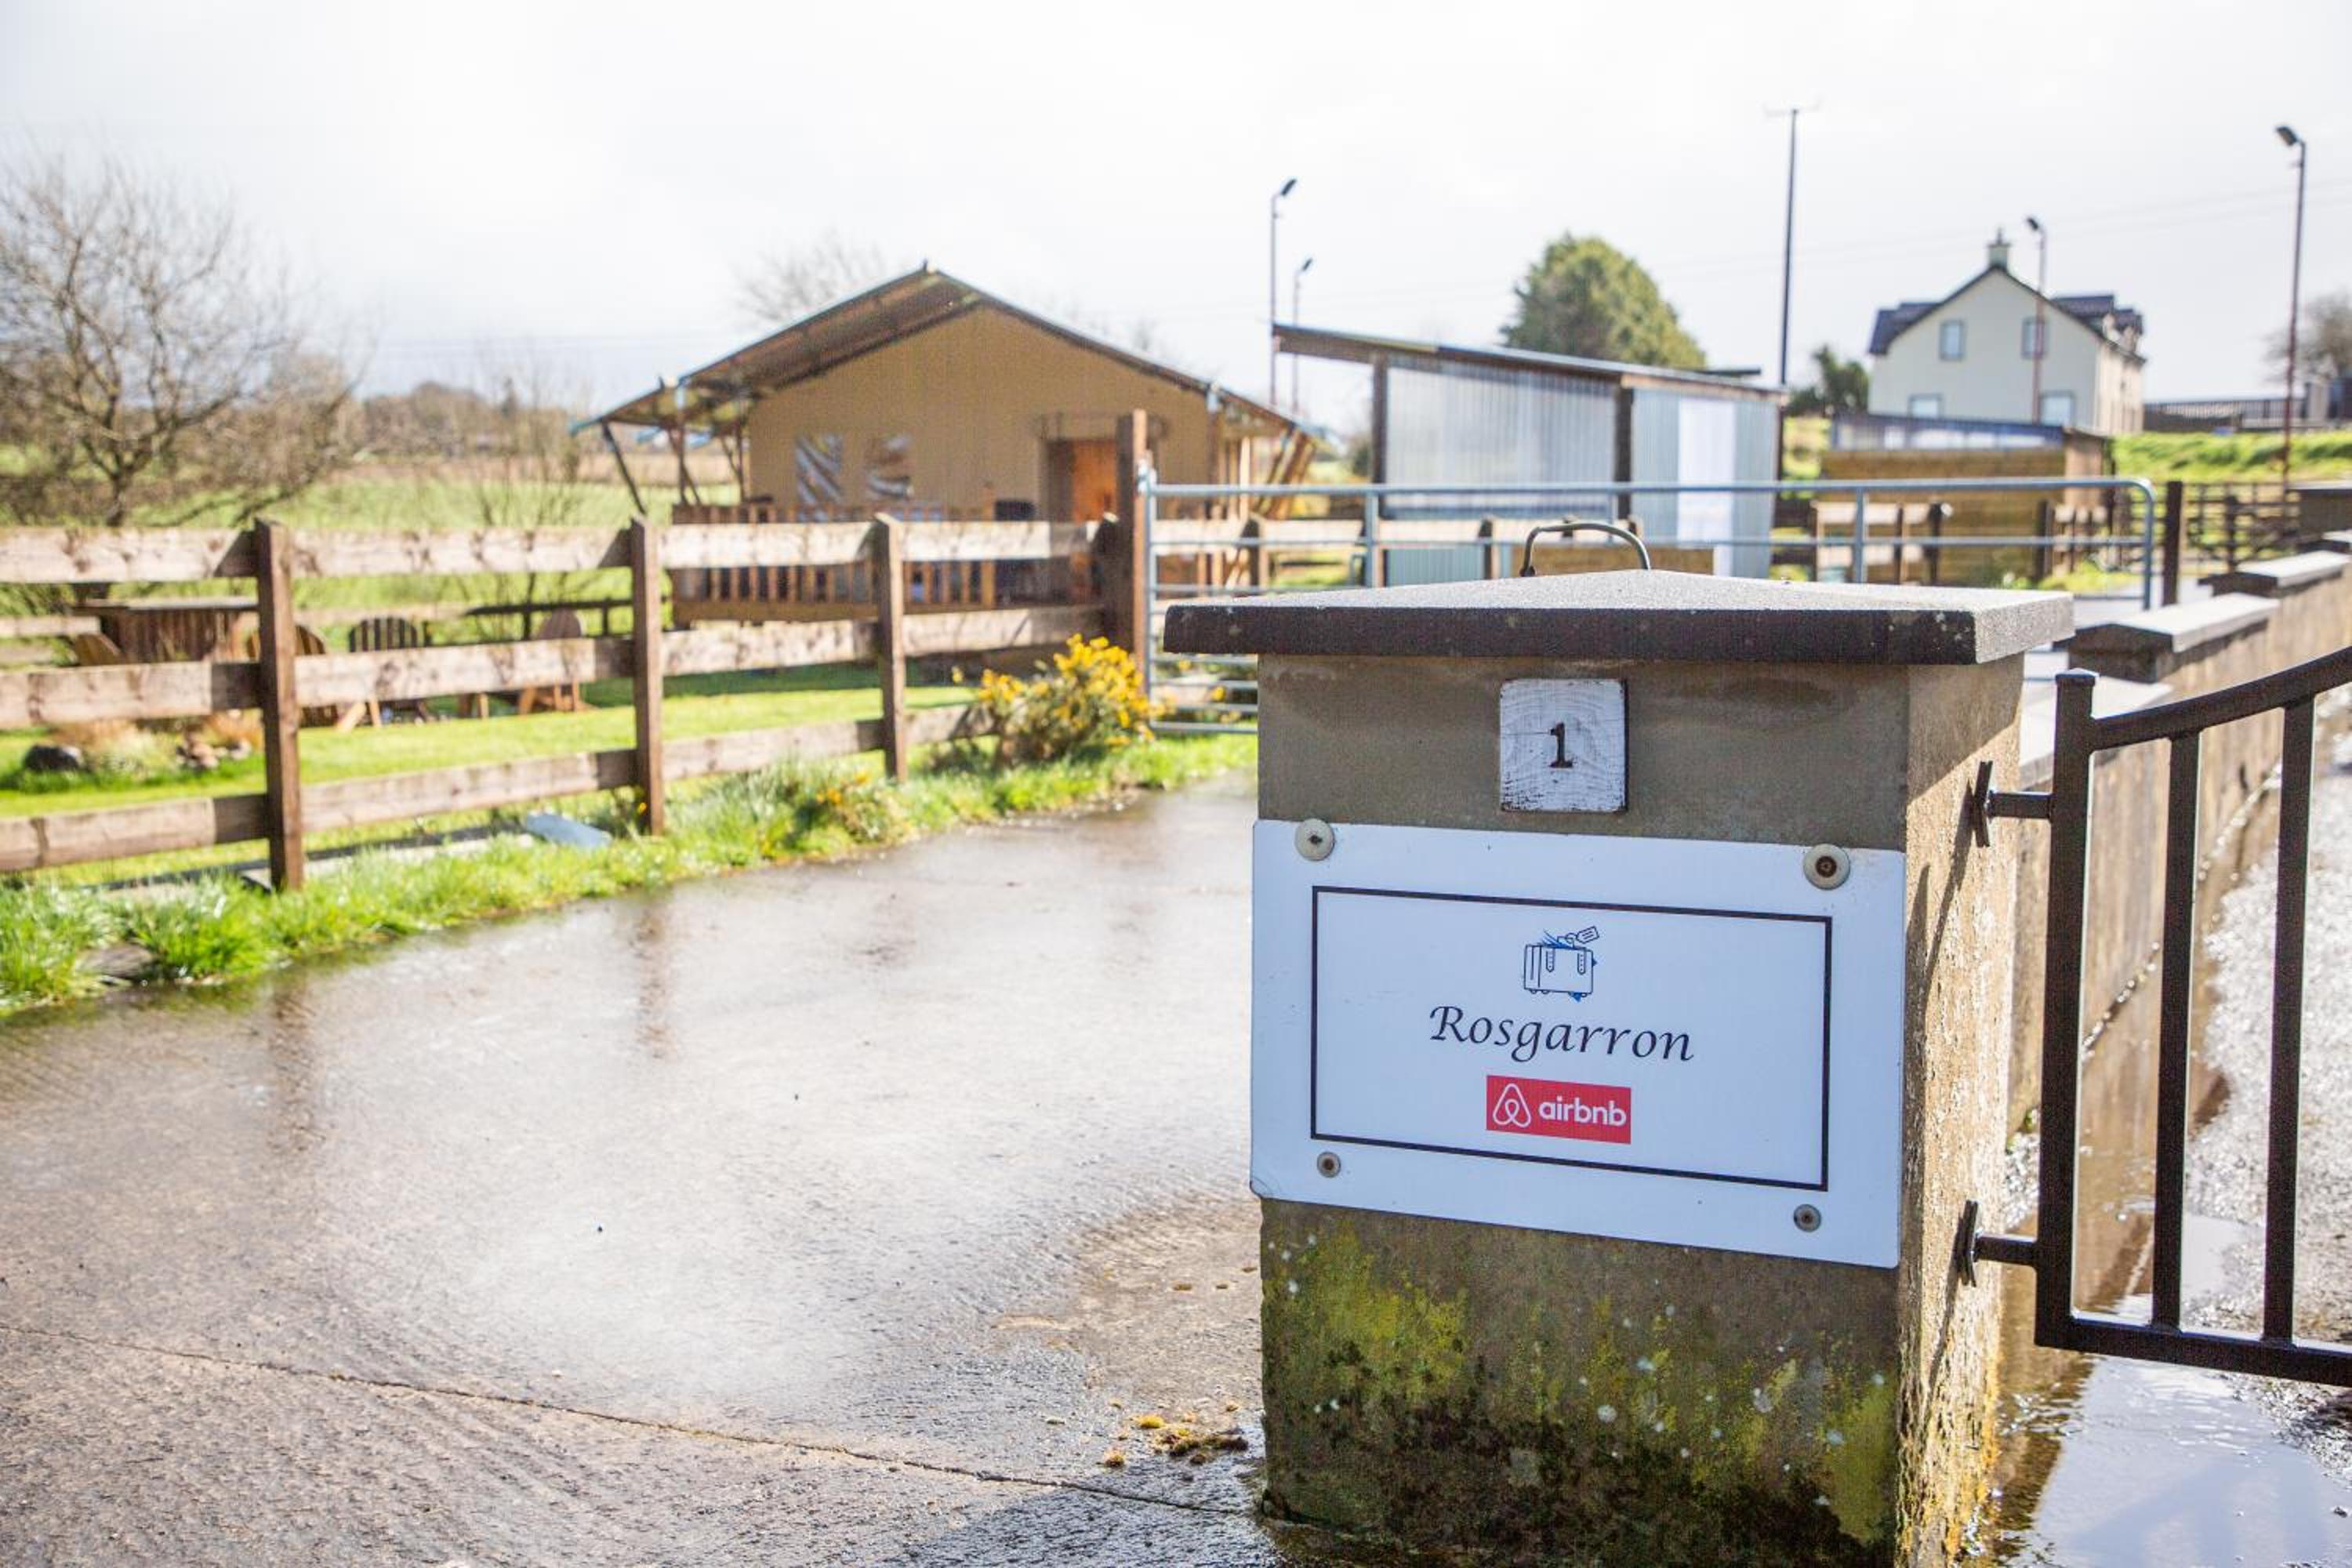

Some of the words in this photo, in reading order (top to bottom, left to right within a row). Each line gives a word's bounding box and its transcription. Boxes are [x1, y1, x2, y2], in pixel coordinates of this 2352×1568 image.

[1549, 722, 1573, 769] 1
[1429, 1005, 1694, 1062] Rosgarron
[1538, 1097, 1627, 1127] airbnb
